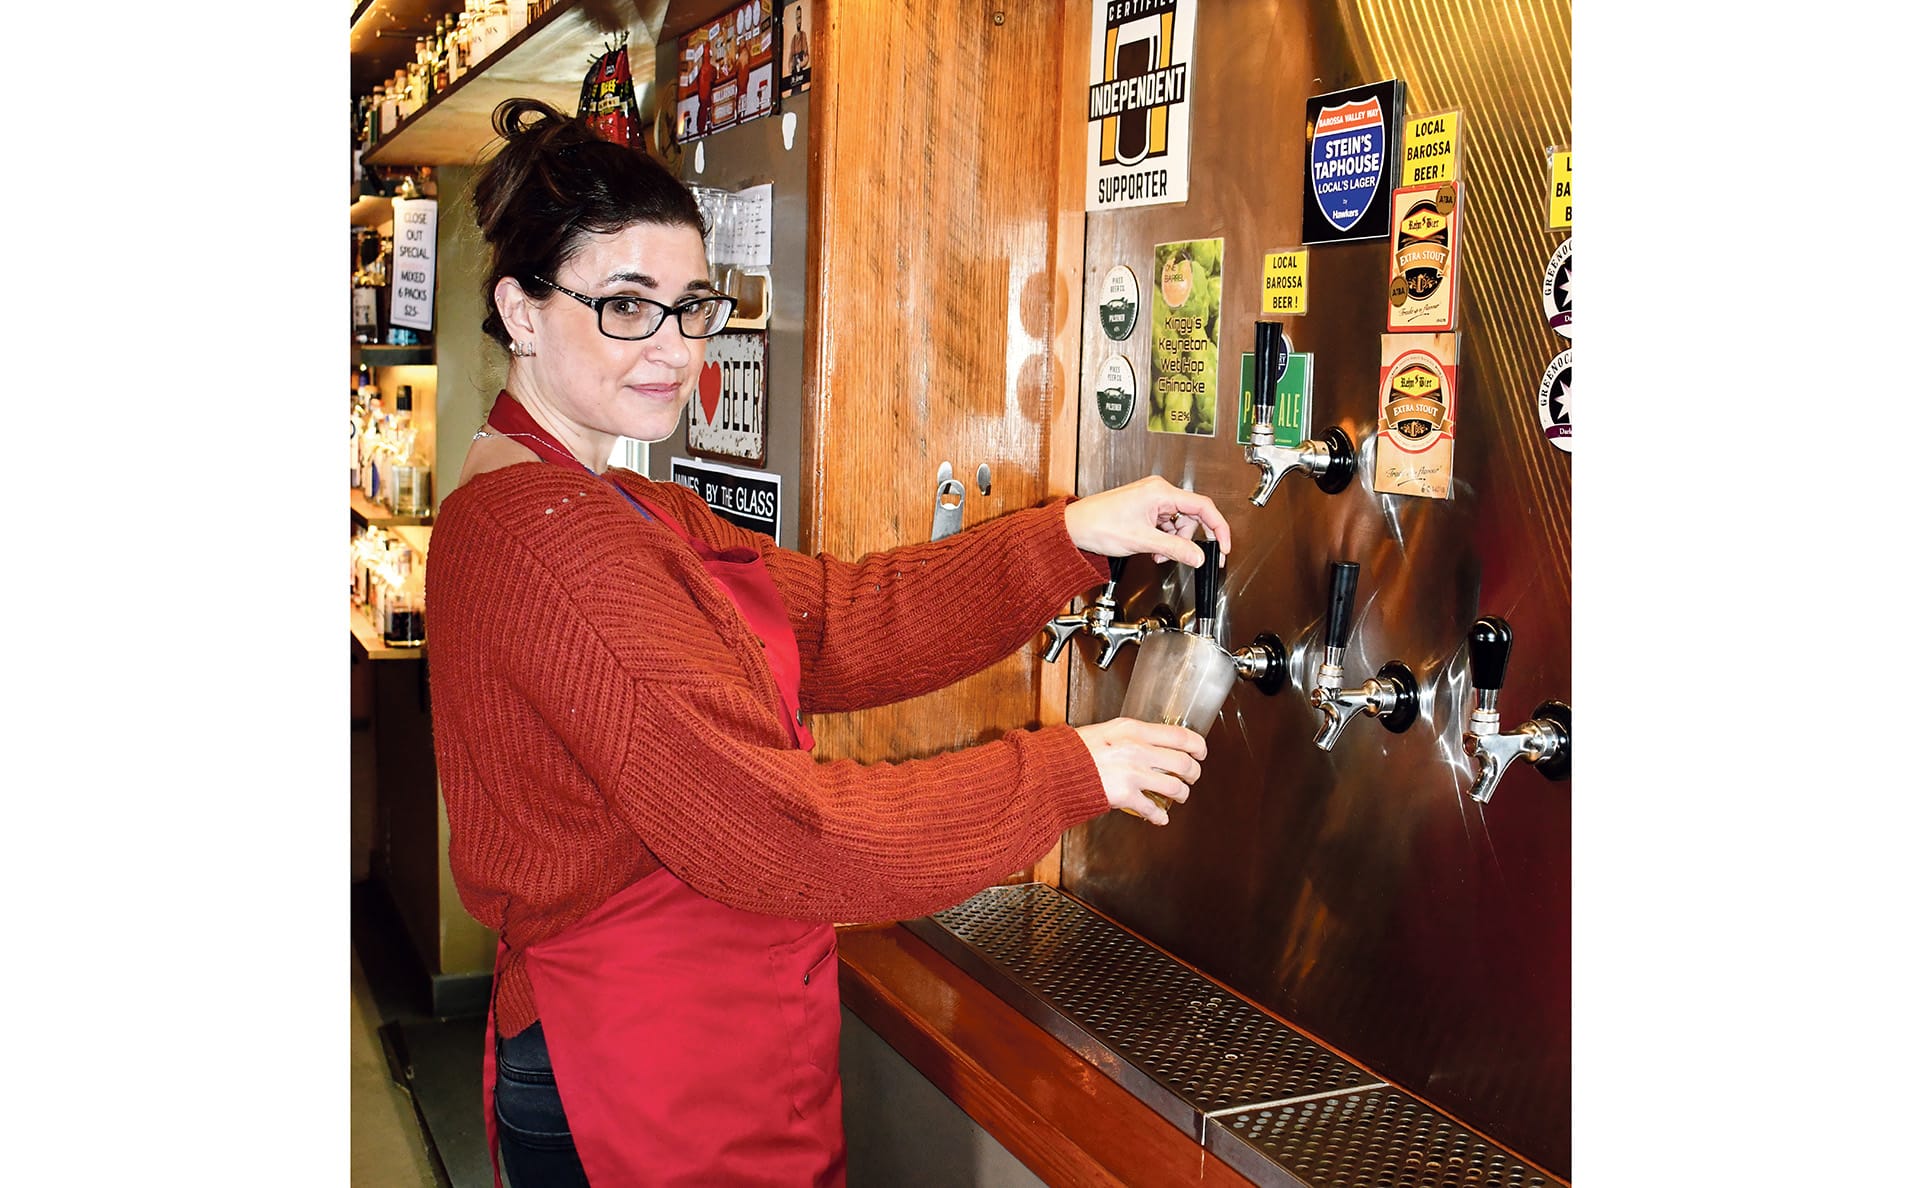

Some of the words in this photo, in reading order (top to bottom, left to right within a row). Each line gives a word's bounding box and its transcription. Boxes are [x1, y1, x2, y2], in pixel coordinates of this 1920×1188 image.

[1108, 0, 1175, 21] CERTIFI
[1090, 66, 1185, 118] INDEPENDENT
[1415, 119, 1445, 137] LOCAL
[1325, 133, 1372, 159] STEIN'S
[1407, 140, 1450, 161] BAROSSA
[1315, 152, 1380, 180] TAPHOUSE
[1414, 165, 1438, 182] BEER
[1098, 169, 1168, 204] SUPPORTER
[1318, 180, 1349, 195] LOCAL'S
[1350, 176, 1376, 190] LAGER
[404, 213, 428, 225] CLOSE
[406, 229, 423, 241] OUT
[400, 246, 429, 260] SPECIAL
[1399, 251, 1421, 267] EXTRA
[1421, 250, 1446, 264] STOUT
[1272, 256, 1297, 269] LOCAL
[401, 271, 425, 284] MIXED
[1266, 276, 1303, 289] BAROSSA
[398, 287, 403, 298] 6
[405, 288, 427, 301] PACKS
[1272, 296, 1293, 309] BEER
[1164, 317, 1202, 334] Kingy's
[1159, 337, 1208, 354] Keyneton
[1161, 359, 1180, 371] Wet
[1183, 359, 1205, 374] Hop
[1159, 378, 1206, 394] Chinooke
[722, 360, 761, 434] BEER
[1278, 393, 1300, 428] ALE
[1393, 403, 1414, 417] EXTRA
[1415, 404, 1439, 417] STOUT
[706, 483, 719, 503] BY
[721, 486, 733, 508] THE
[736, 486, 775, 517] GLASS
